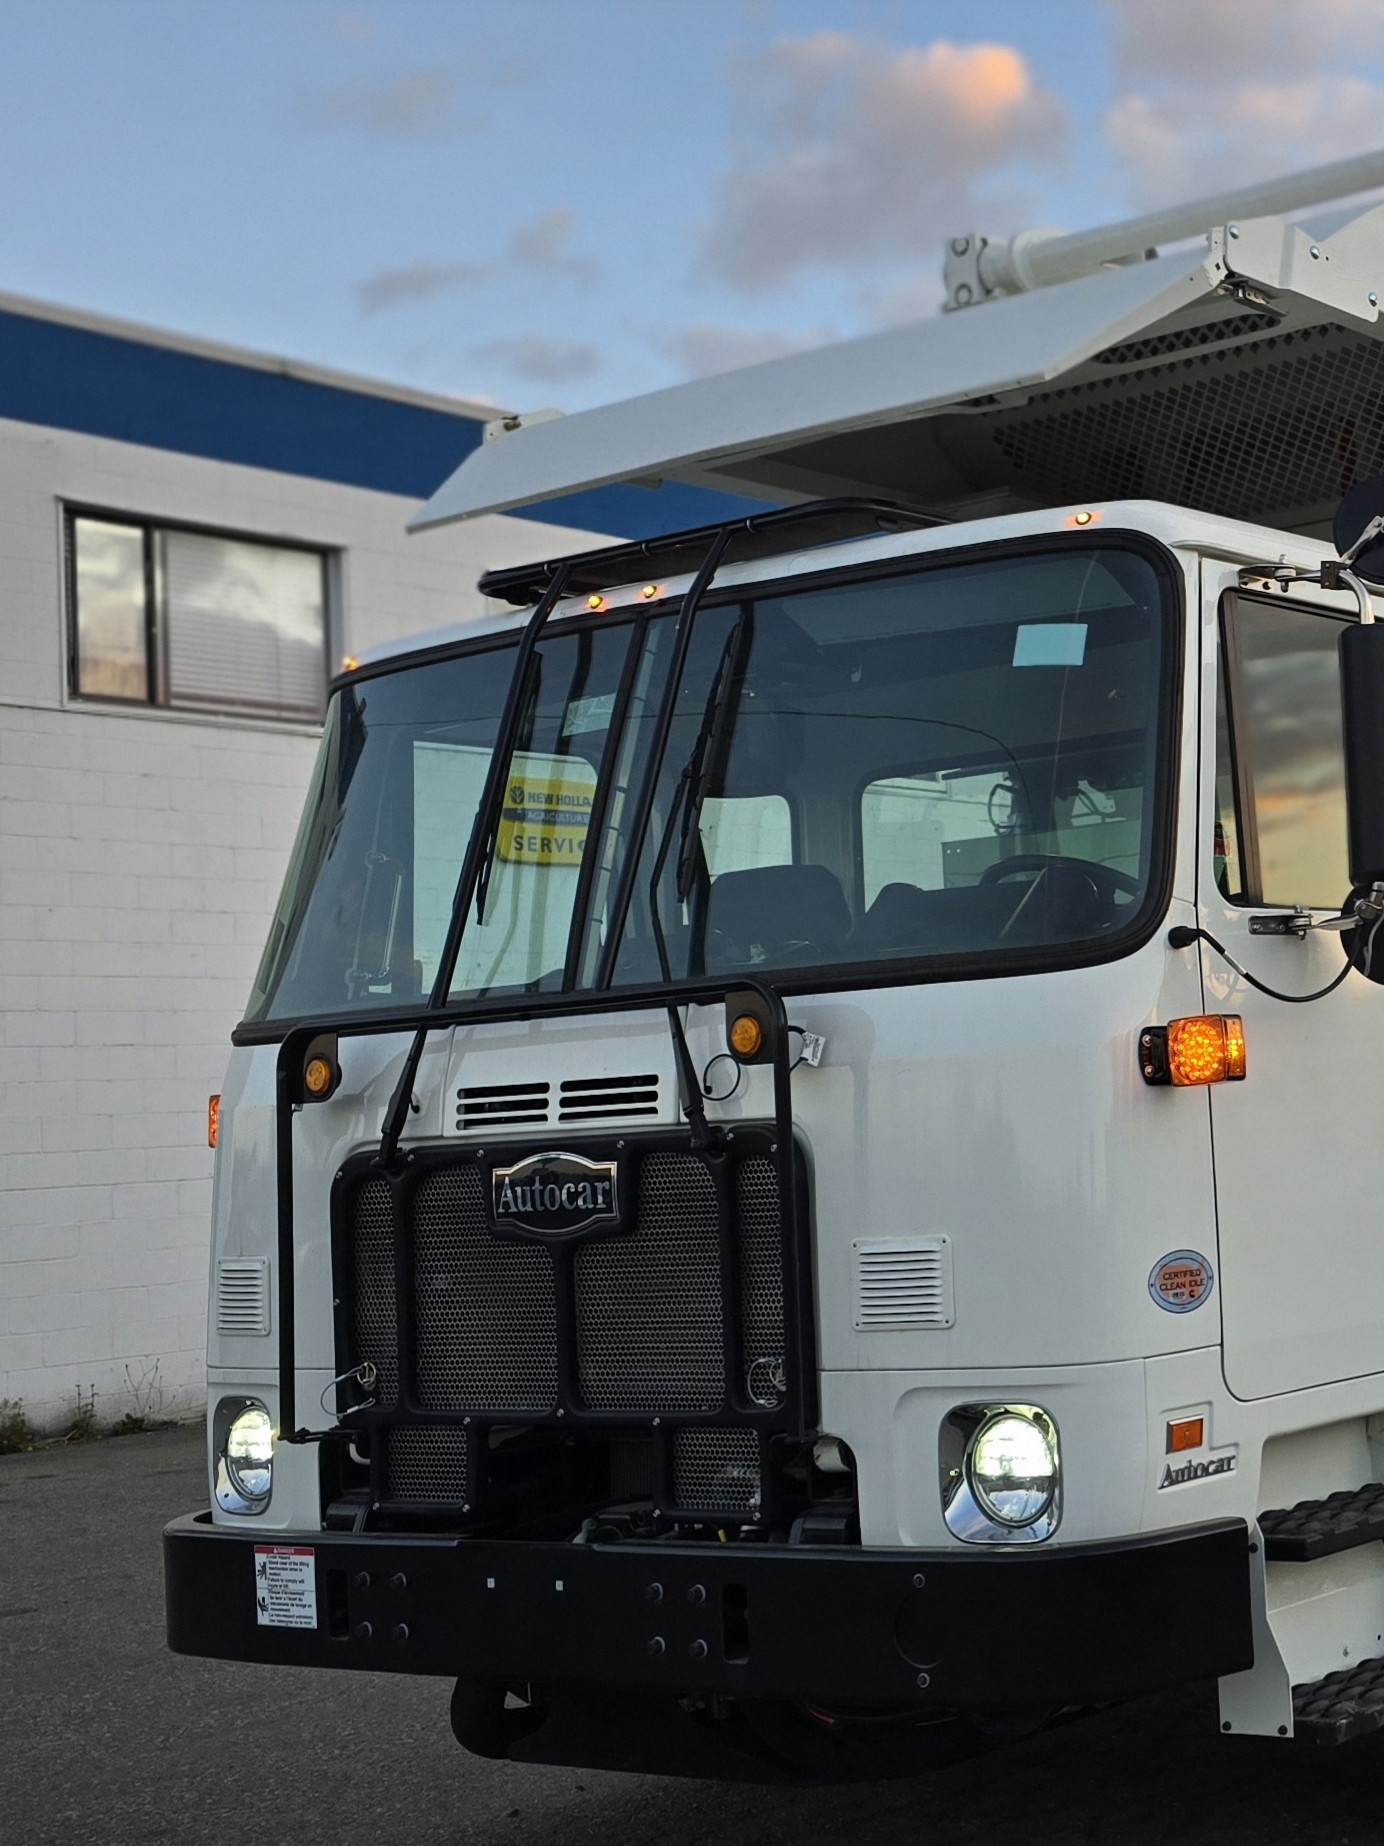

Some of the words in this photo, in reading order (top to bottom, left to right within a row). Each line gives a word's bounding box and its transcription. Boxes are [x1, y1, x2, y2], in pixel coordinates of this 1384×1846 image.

[528, 791, 554, 805] NEW
[497, 1175, 611, 1214] Autocar
[1162, 1268, 1202, 1281] CERTIFIED
[1159, 1281, 1187, 1292] CLEAN
[1188, 1278, 1206, 1288] IDLE
[1157, 1455, 1236, 1490] Autocar
